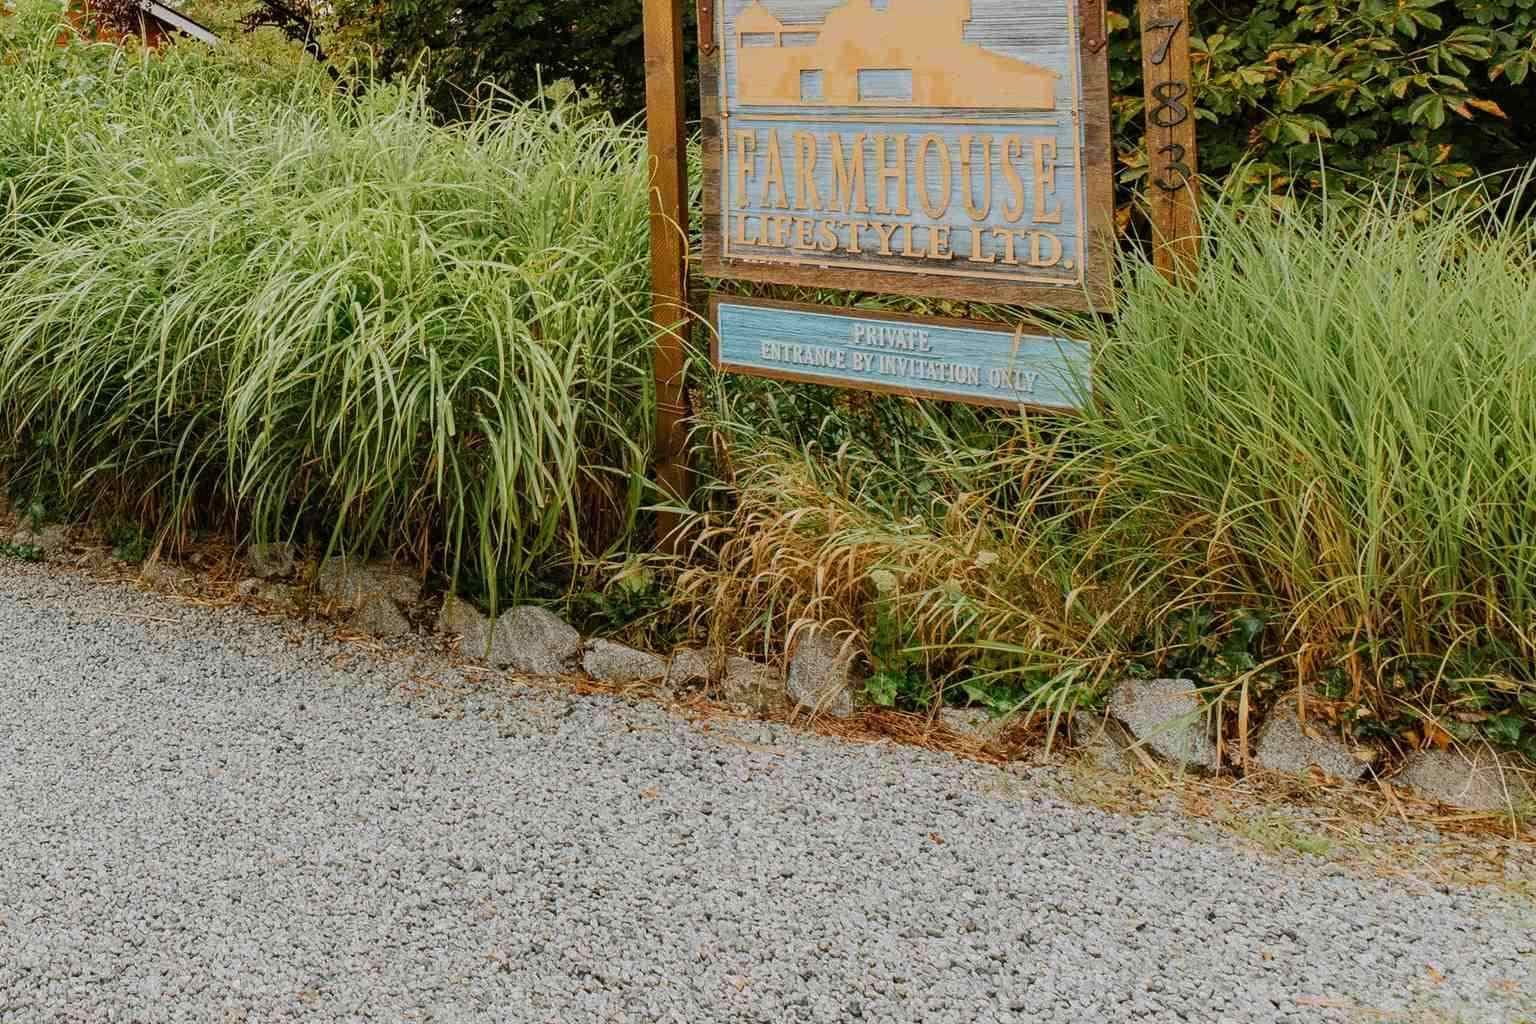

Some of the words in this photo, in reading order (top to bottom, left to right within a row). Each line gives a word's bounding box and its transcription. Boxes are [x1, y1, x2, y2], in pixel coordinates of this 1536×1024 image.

[735, 127, 1062, 224] FARMHOUSE
[734, 213, 955, 260] LIFESTYLE
[967, 226, 1075, 270] LTD.
[853, 323, 932, 352] PRIVATE
[760, 342, 847, 371] ENTRANCE
[851, 352, 875, 373] BY
[879, 355, 980, 386] INVITATION
[989, 367, 1039, 393] ONLY
